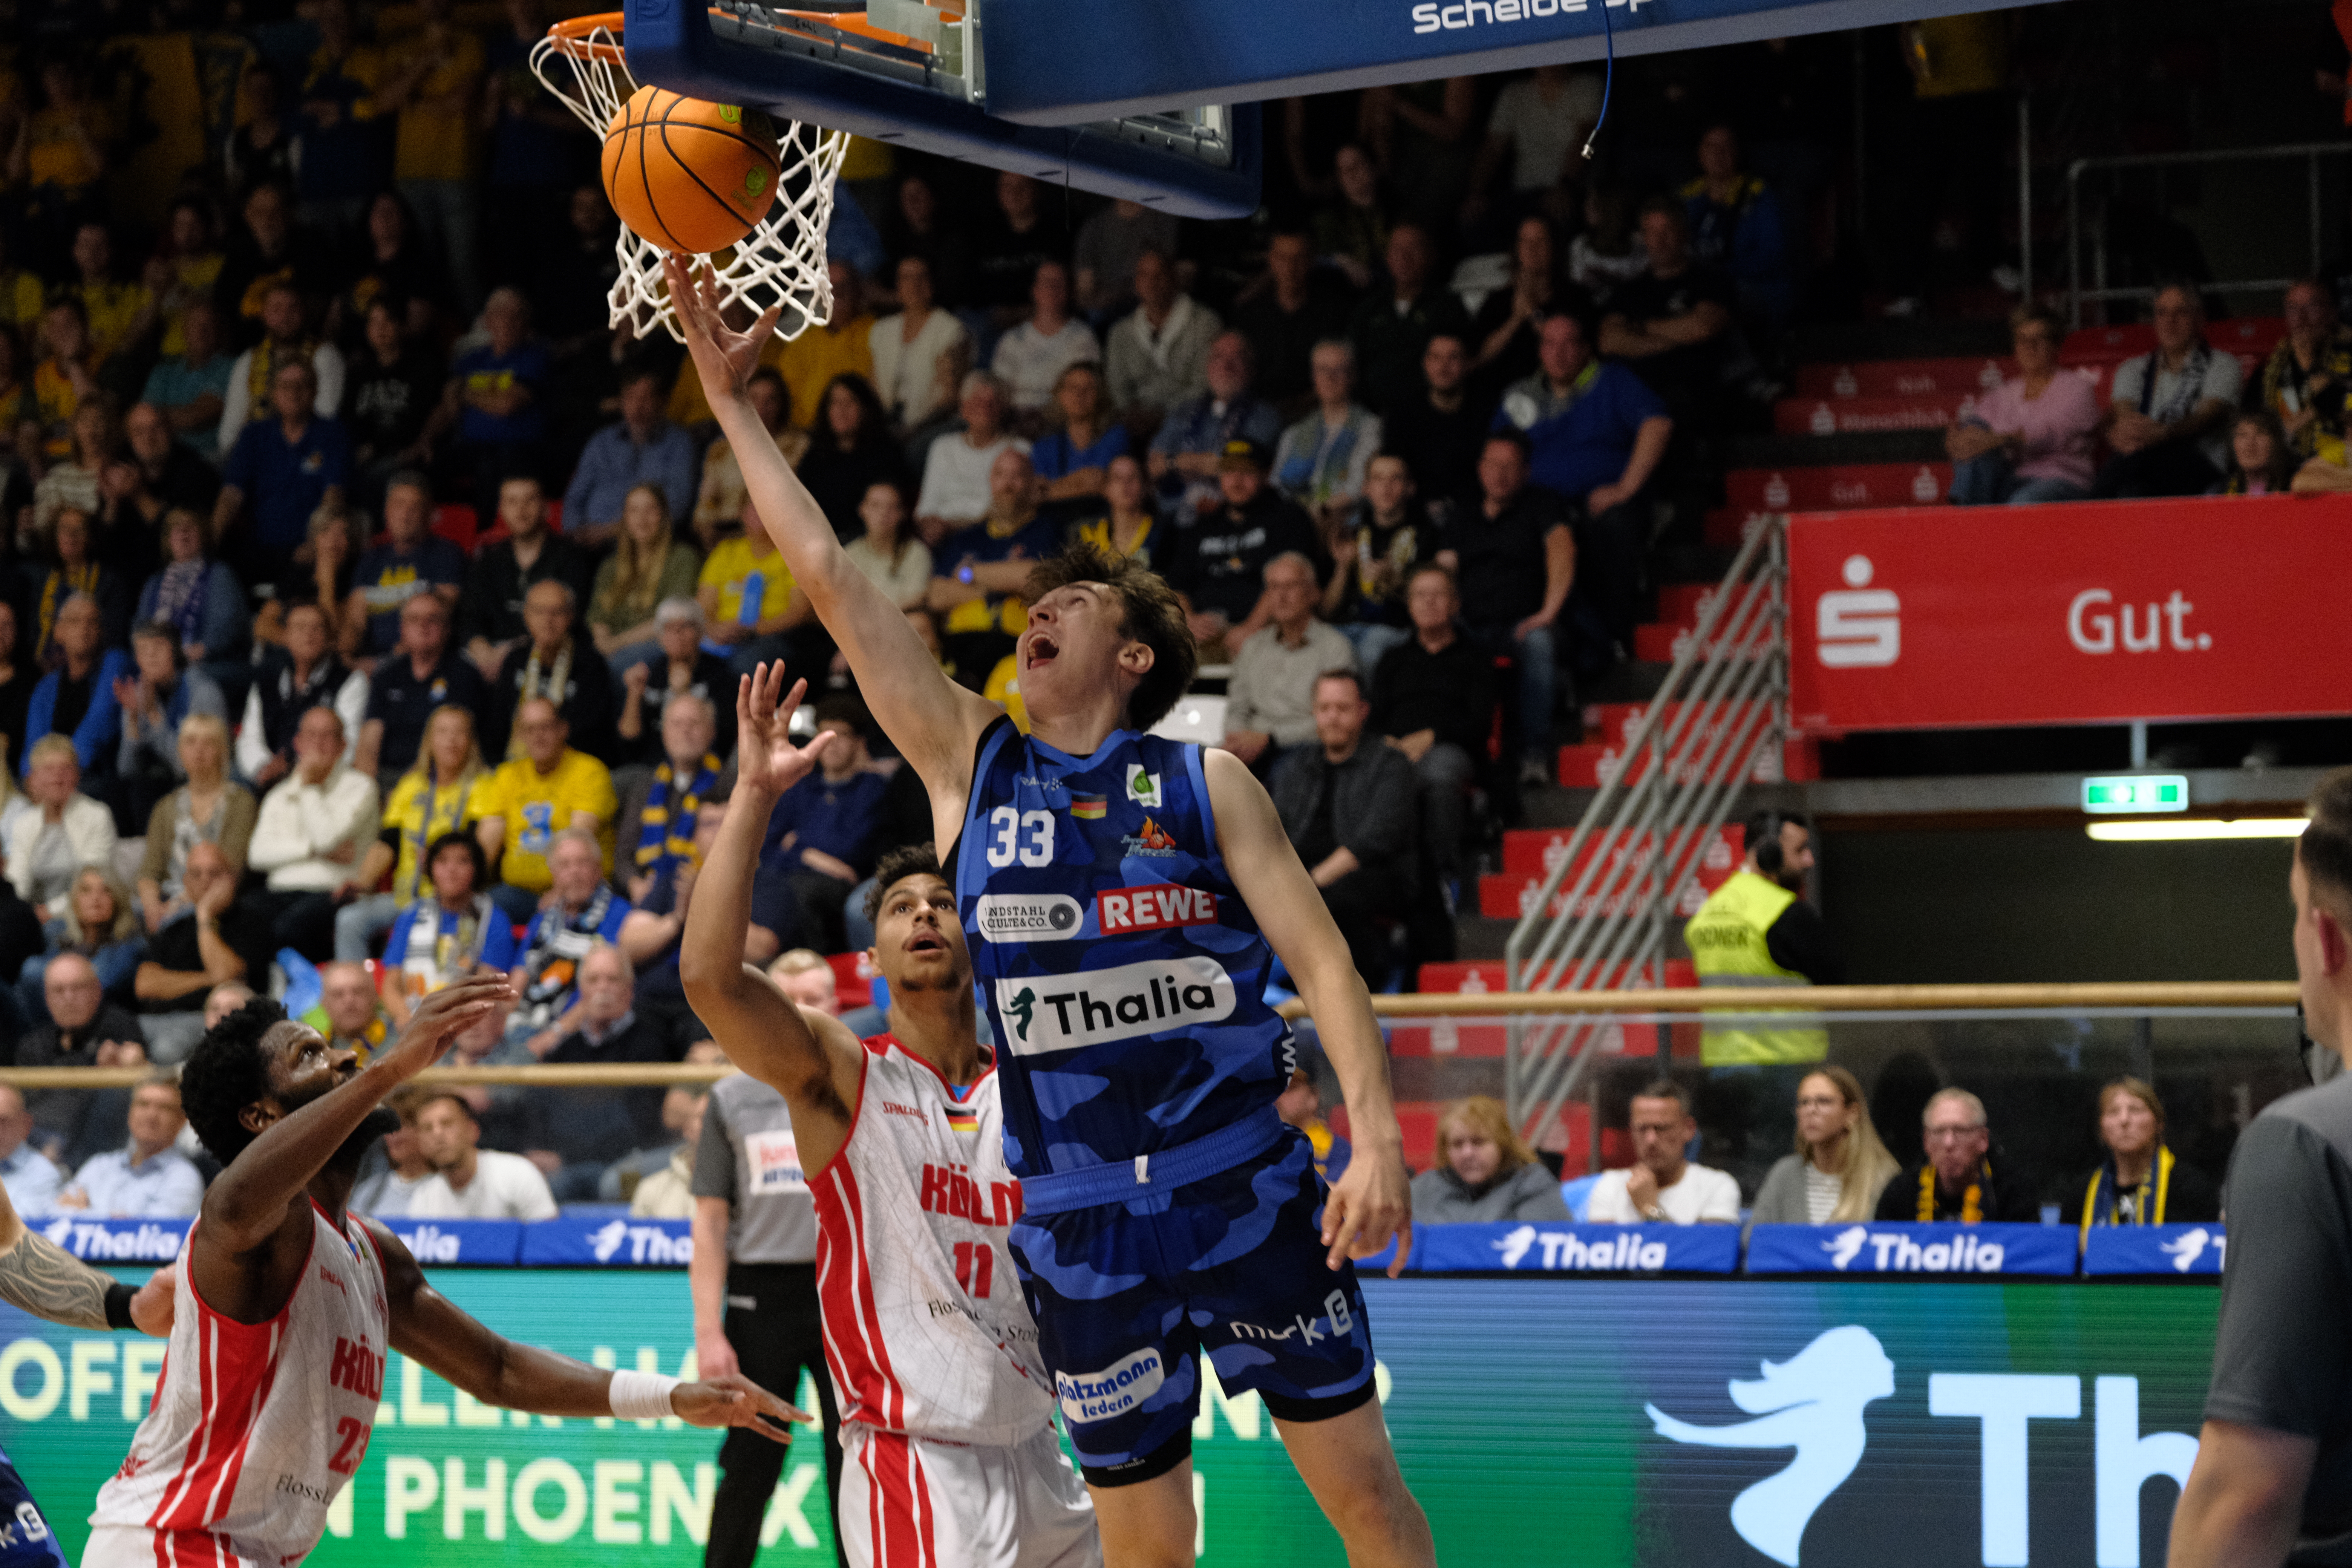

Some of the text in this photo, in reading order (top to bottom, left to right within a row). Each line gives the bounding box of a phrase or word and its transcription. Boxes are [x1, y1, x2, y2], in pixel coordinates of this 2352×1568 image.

[2067, 588, 2213, 655] Gut.
[987, 805, 1055, 868] 33
[1103, 888, 1214, 929] REWE
[1043, 975, 1215, 1035] Thalia
[920, 1161, 1023, 1227] KÖLN
[74, 1223, 181, 1260] Thalia
[953, 1241, 993, 1300] 11
[1539, 1232, 1667, 1271] Thalia
[1870, 1233, 2005, 1272] Thalia
[1058, 1356, 1159, 1403] platzmann
[383, 1454, 821, 1548] PHOENX
